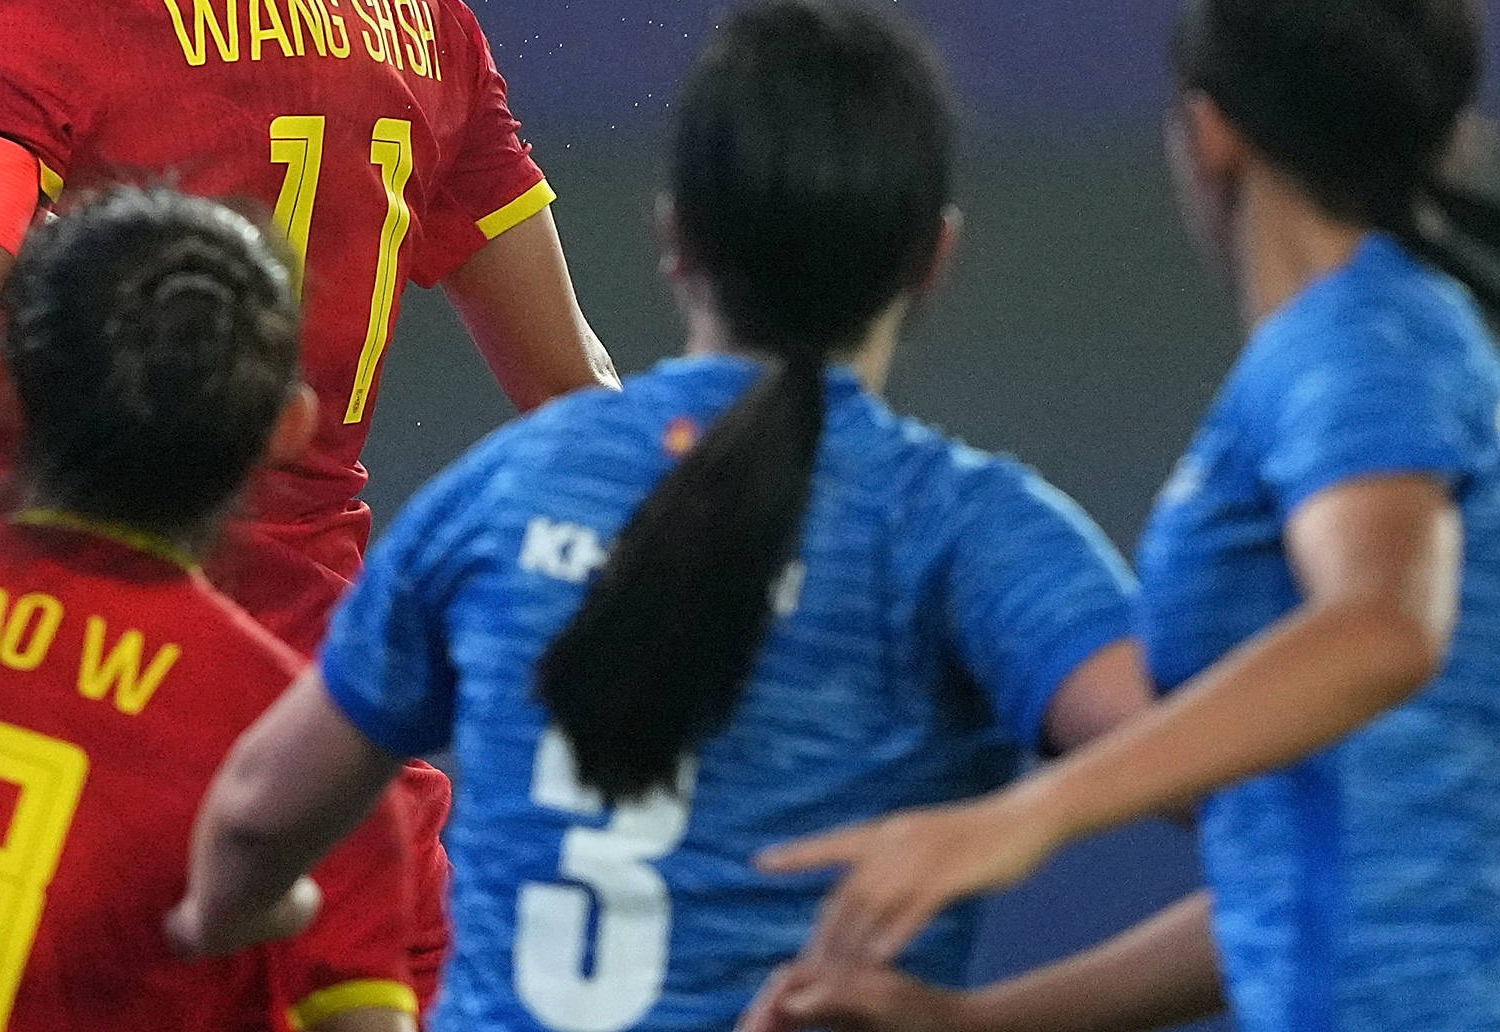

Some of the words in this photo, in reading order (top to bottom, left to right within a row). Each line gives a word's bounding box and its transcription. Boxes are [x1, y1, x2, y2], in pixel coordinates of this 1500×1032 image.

[269, 115, 412, 424] 11
[76, 615, 181, 715] W
[513, 726, 700, 1032] 3
